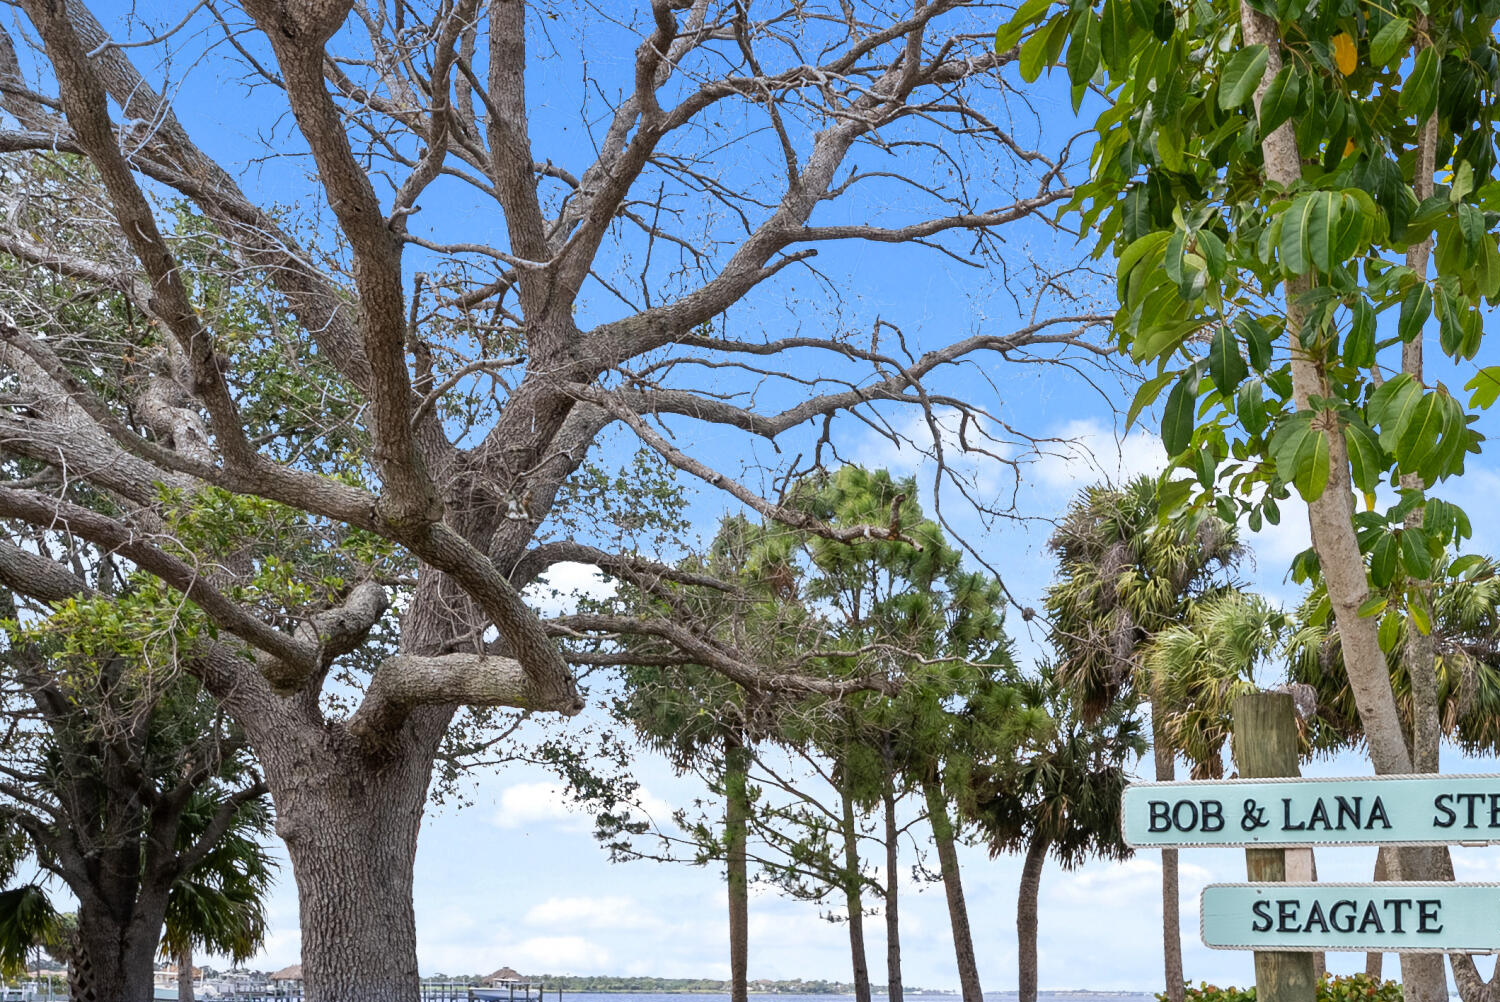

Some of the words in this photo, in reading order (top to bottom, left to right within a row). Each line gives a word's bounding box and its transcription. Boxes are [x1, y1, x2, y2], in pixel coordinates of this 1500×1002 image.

[1147, 800, 1225, 834] BOB
[1240, 798, 1270, 833] &
[1281, 796, 1393, 831] LANA
[1251, 899, 1444, 934] SEAGATE
